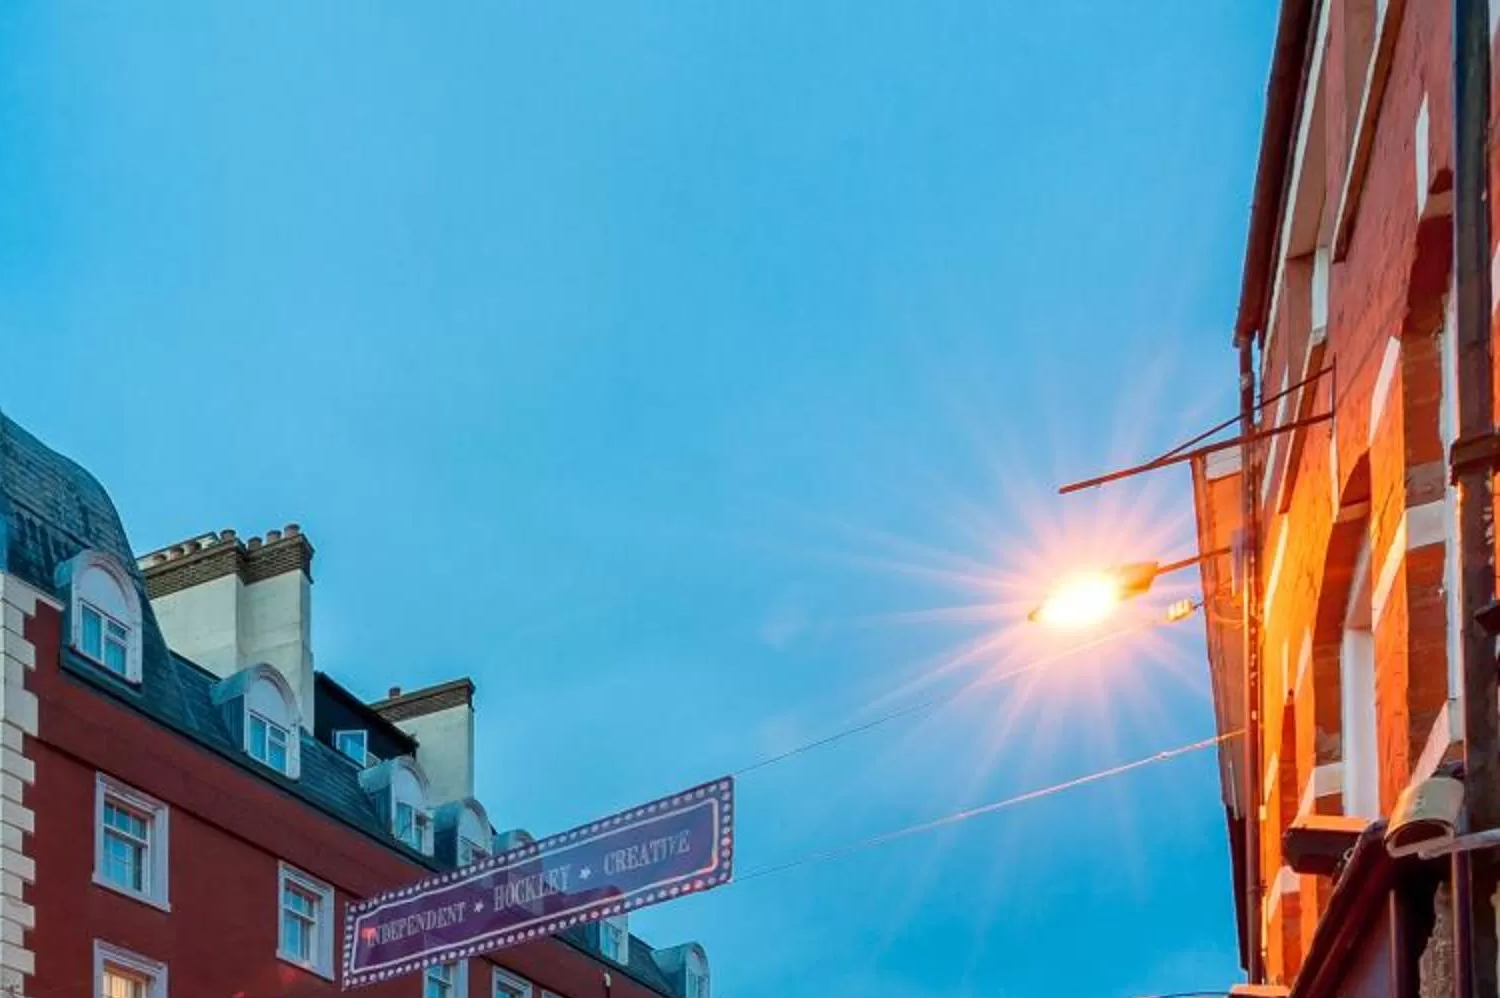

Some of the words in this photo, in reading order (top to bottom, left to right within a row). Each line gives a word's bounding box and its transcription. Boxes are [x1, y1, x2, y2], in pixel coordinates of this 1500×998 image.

[365, 902, 467, 947] INDEPENDENT
[493, 864, 571, 912] HOCKLEY
[603, 830, 692, 876] CREATIVE
